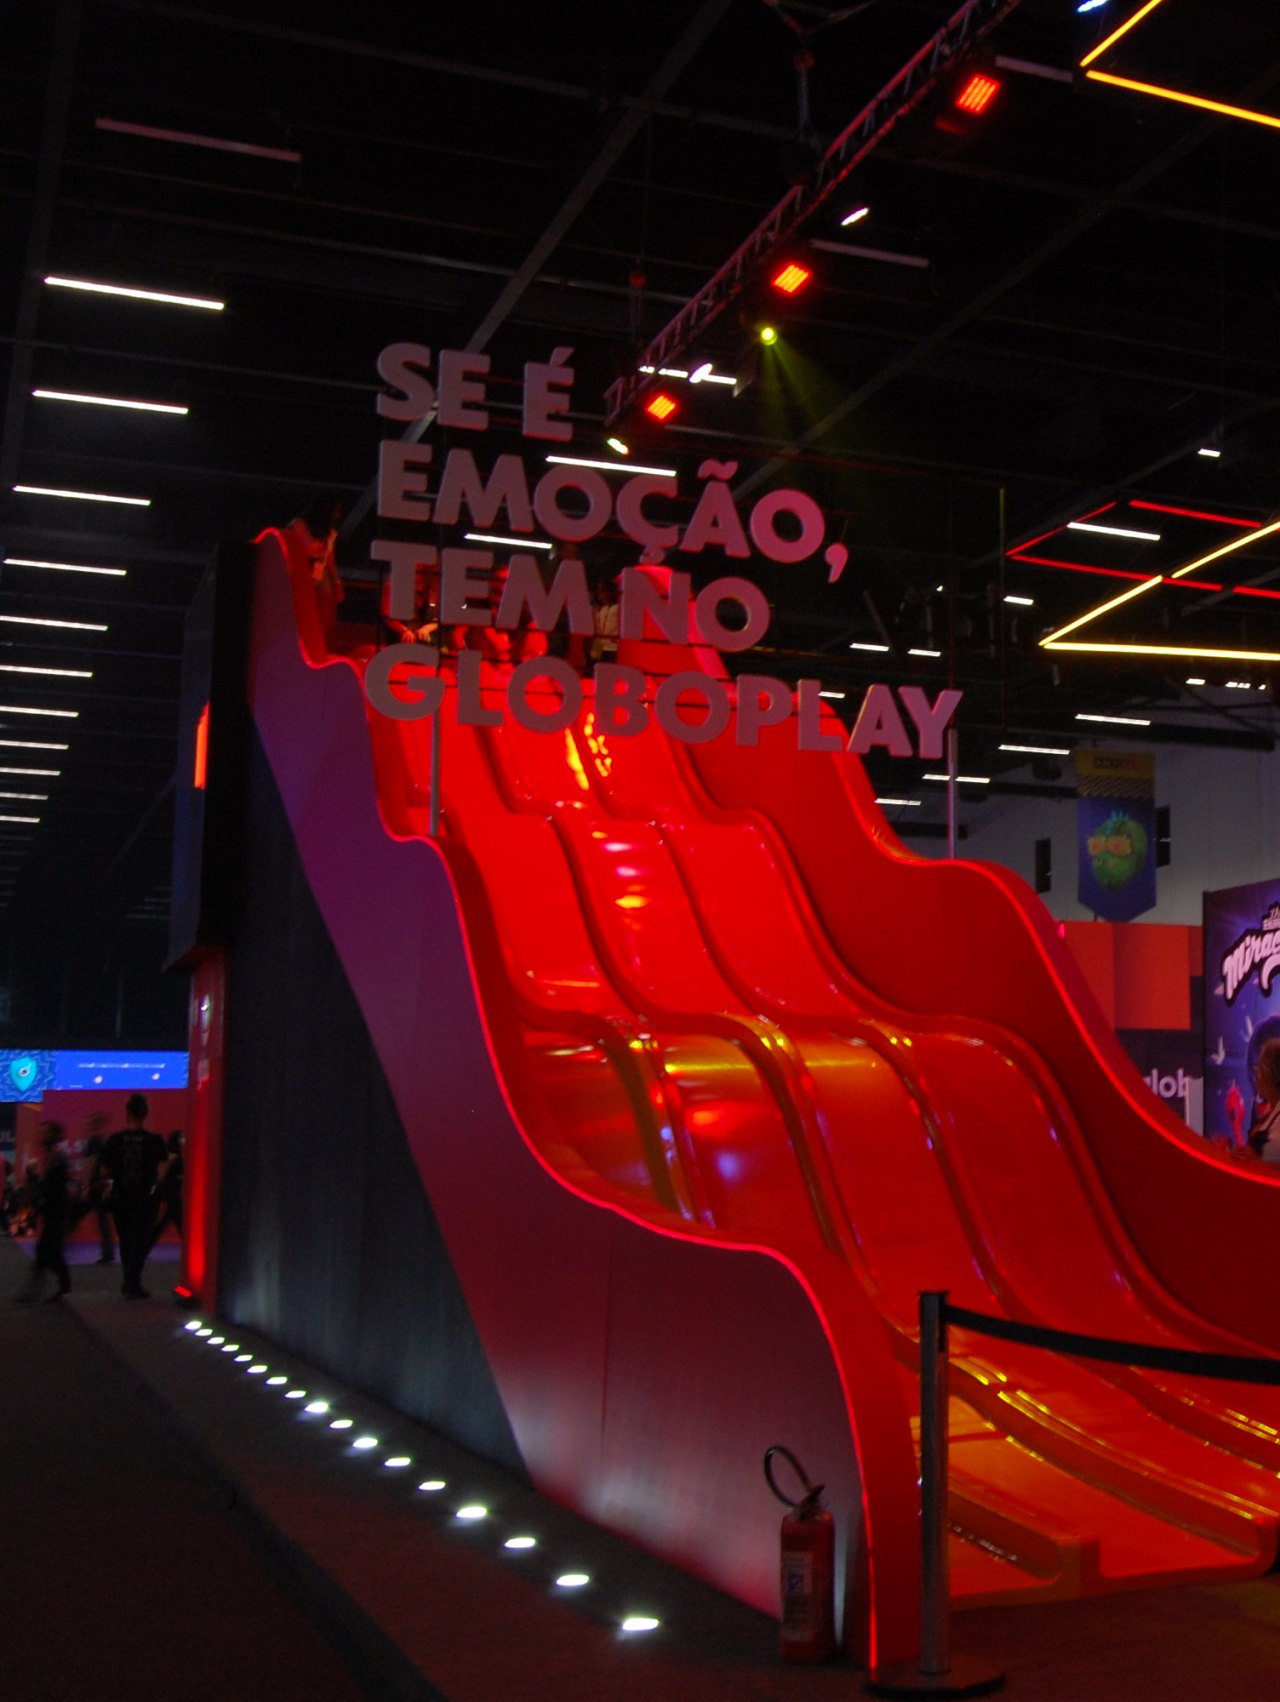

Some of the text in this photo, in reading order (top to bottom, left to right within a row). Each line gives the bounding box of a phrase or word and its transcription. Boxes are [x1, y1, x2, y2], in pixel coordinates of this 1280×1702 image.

[376, 342, 575, 442] SE É
[377, 439, 850, 584] EMOÇÃO,
[370, 540, 771, 654] TEM NO
[364, 643, 963, 760] GLOBOPLAY
